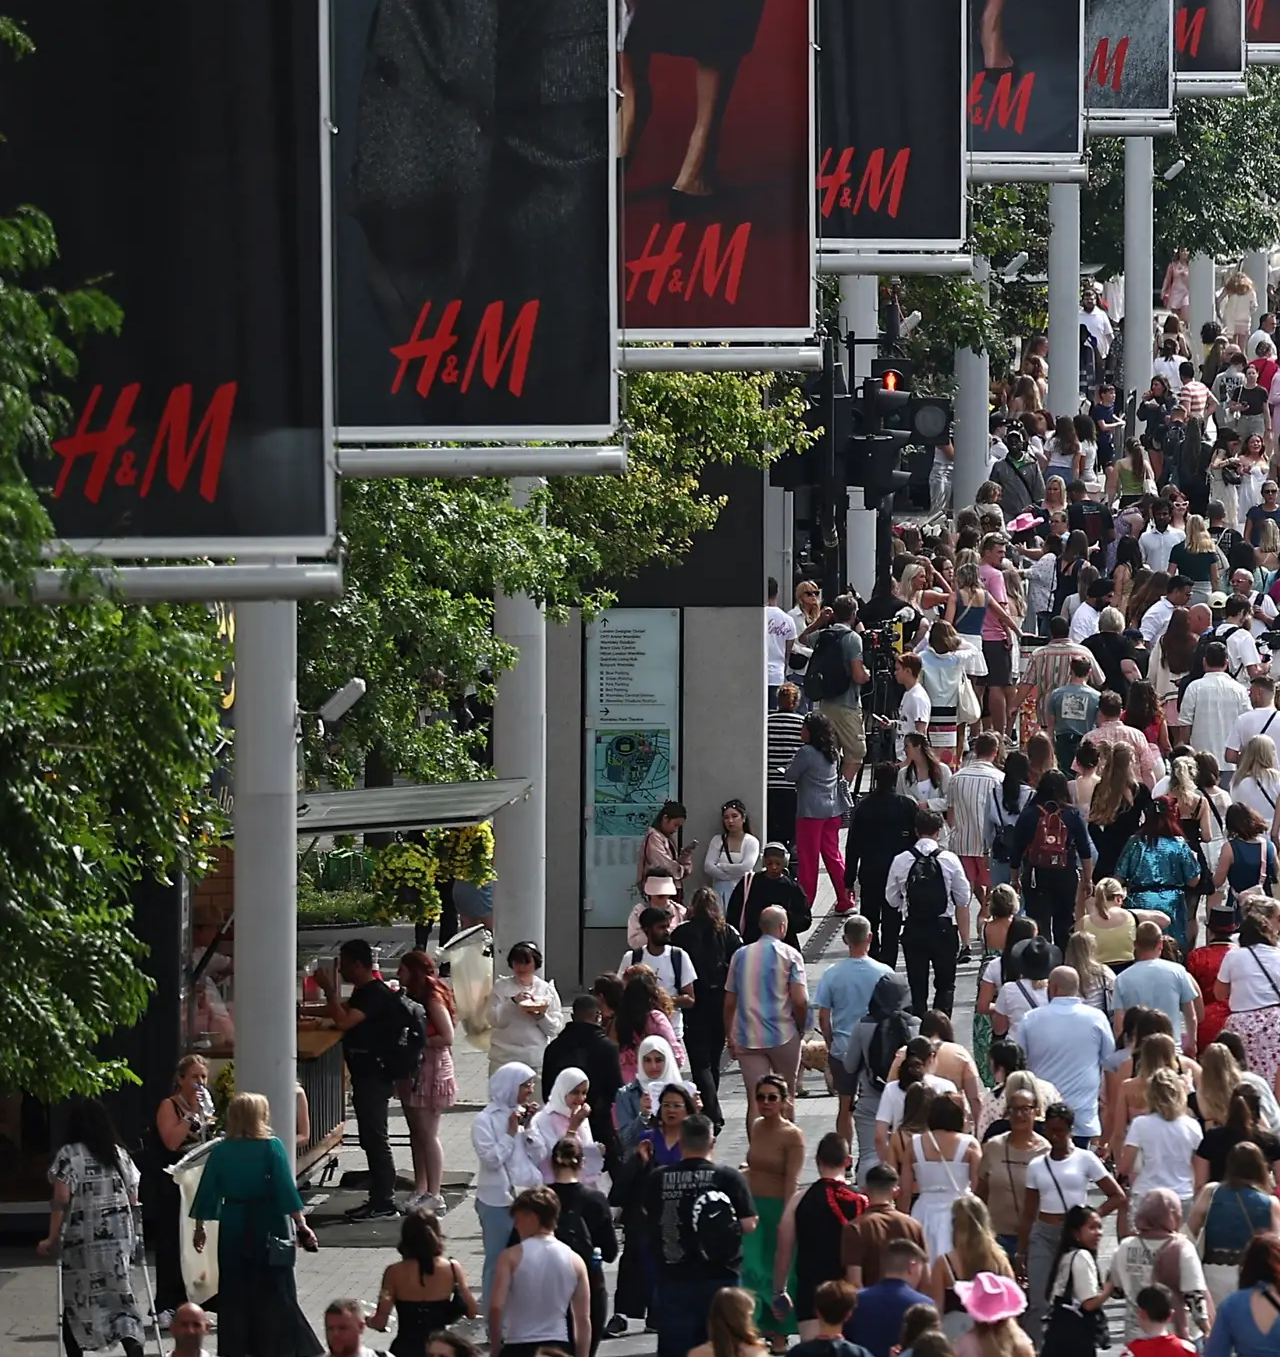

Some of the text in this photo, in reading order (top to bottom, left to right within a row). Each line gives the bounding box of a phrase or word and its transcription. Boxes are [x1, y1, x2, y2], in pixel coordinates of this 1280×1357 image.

[625, 212, 752, 305] H&M
[390, 299, 540, 398] H&M
[53, 380, 239, 504] H&M
